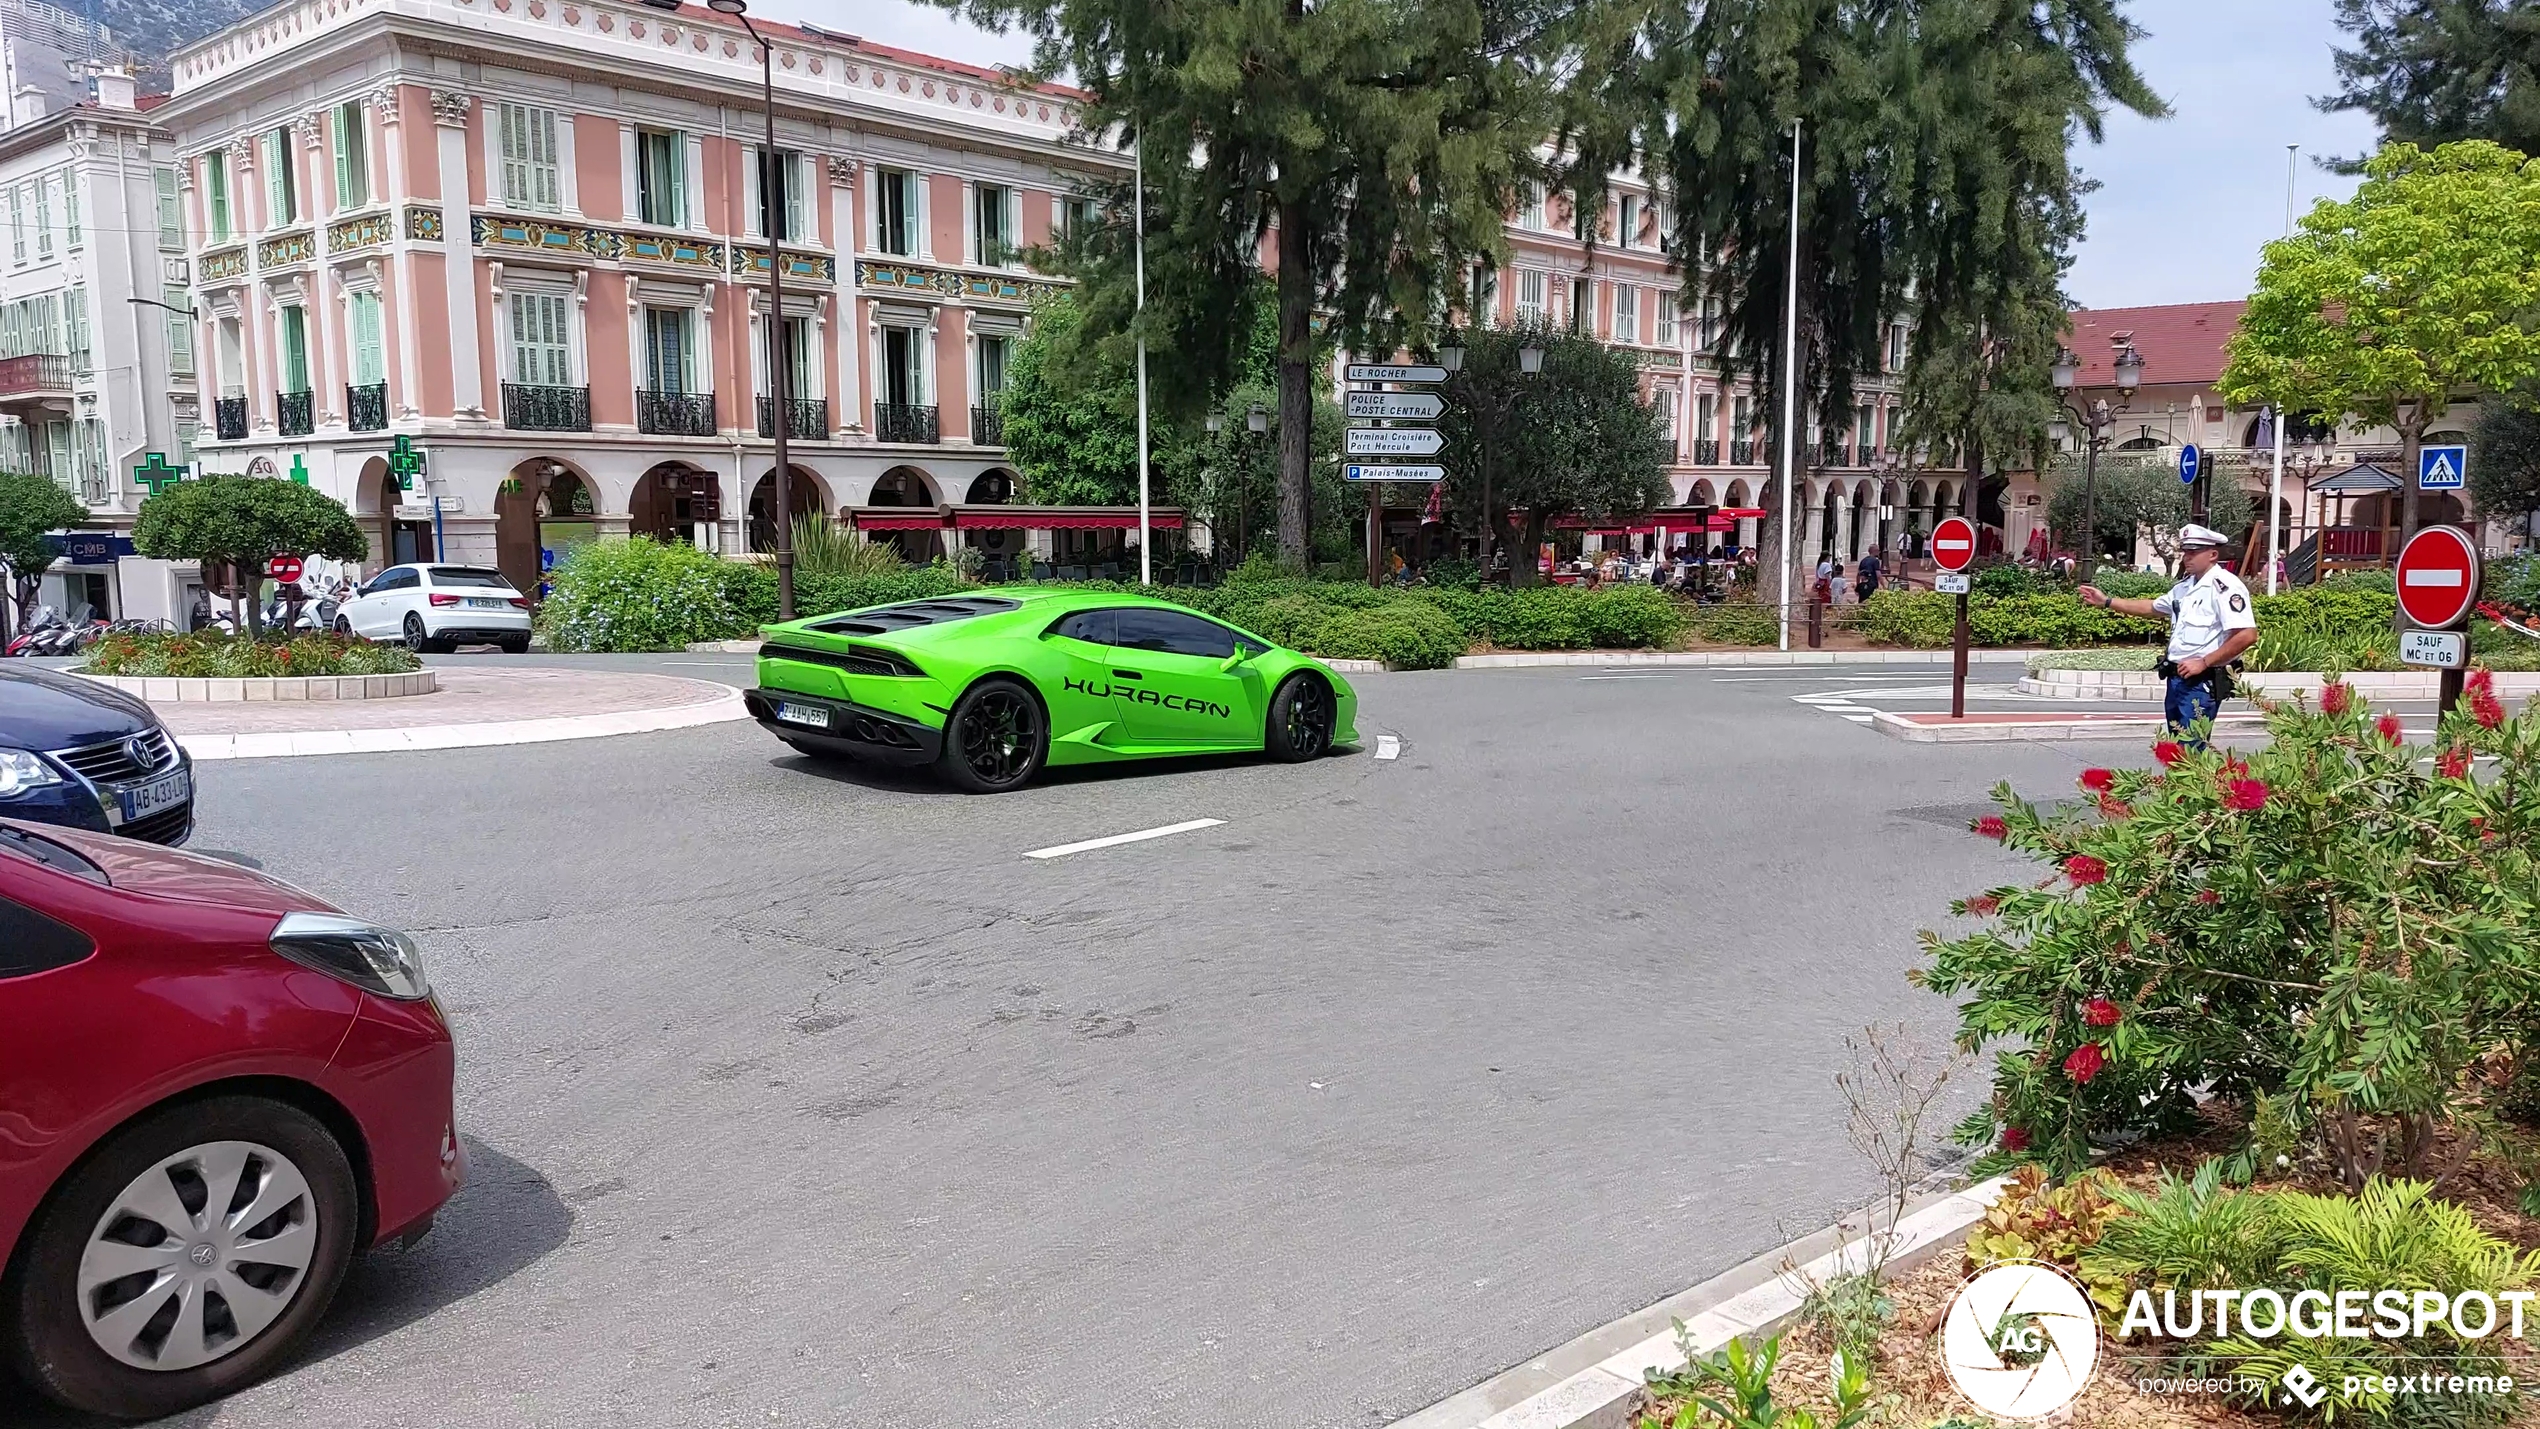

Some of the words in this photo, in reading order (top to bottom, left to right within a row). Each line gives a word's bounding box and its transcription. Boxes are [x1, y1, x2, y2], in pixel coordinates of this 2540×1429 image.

[1352, 368, 1363, 377] LE
[1367, 369, 1407, 378] ROCHER
[1351, 395, 1386, 404] POLICE
[1351, 405, 1386, 415] -POSTE
[1389, 407, 1432, 416] CENTRAL
[1350, 432, 1388, 441] Terminal
[1391, 432, 1432, 442] Croisière
[1350, 442, 1371, 451] Port
[1374, 442, 1411, 451] Hercule
[1363, 468, 1429, 477] Palais-Musées
[73, 542, 107, 555] CMB
[2416, 635, 2443, 647] SAUF
[2406, 648, 2421, 660] MC
[2425, 652, 2434, 661] ET
[2438, 651, 2452, 663] 06
